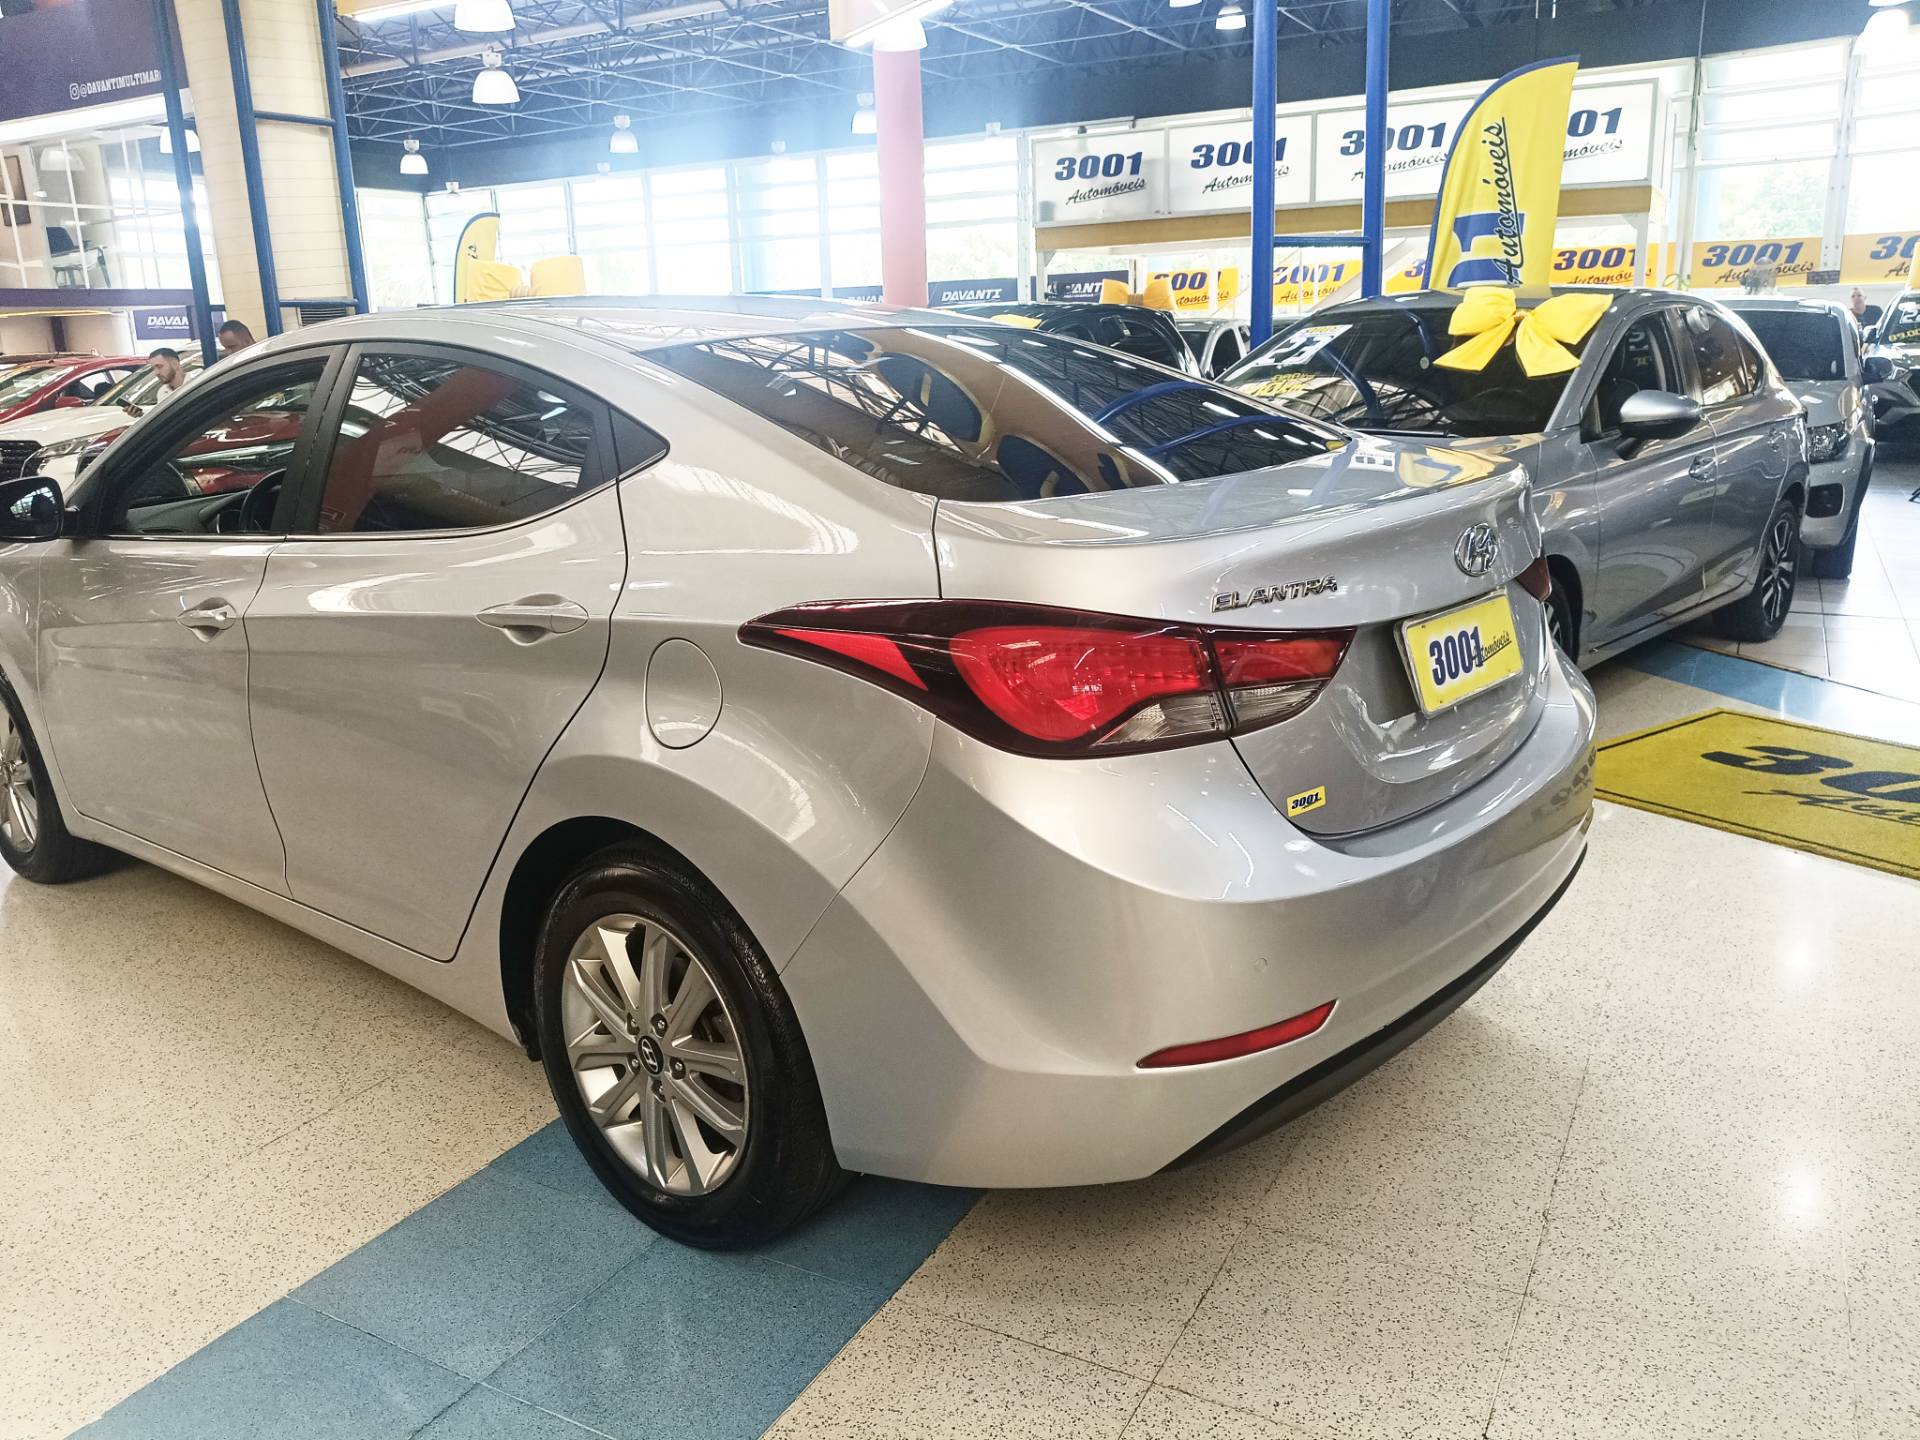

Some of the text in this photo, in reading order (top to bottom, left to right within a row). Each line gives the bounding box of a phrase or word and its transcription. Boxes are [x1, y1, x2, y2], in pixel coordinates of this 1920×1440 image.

[80, 69, 161, 98] @DAVANTIMULTIMAR
[1055, 152, 1143, 180] 3001
[1065, 177, 1147, 205] Automóveis
[1481, 117, 1524, 287] Automóveis
[1702, 242, 1804, 267] 3001
[941, 288, 1003, 302] DAVANTI
[1212, 574, 1338, 613] ELANTRA
[1429, 626, 1484, 686] 3001
[1291, 792, 1320, 810] 3001
